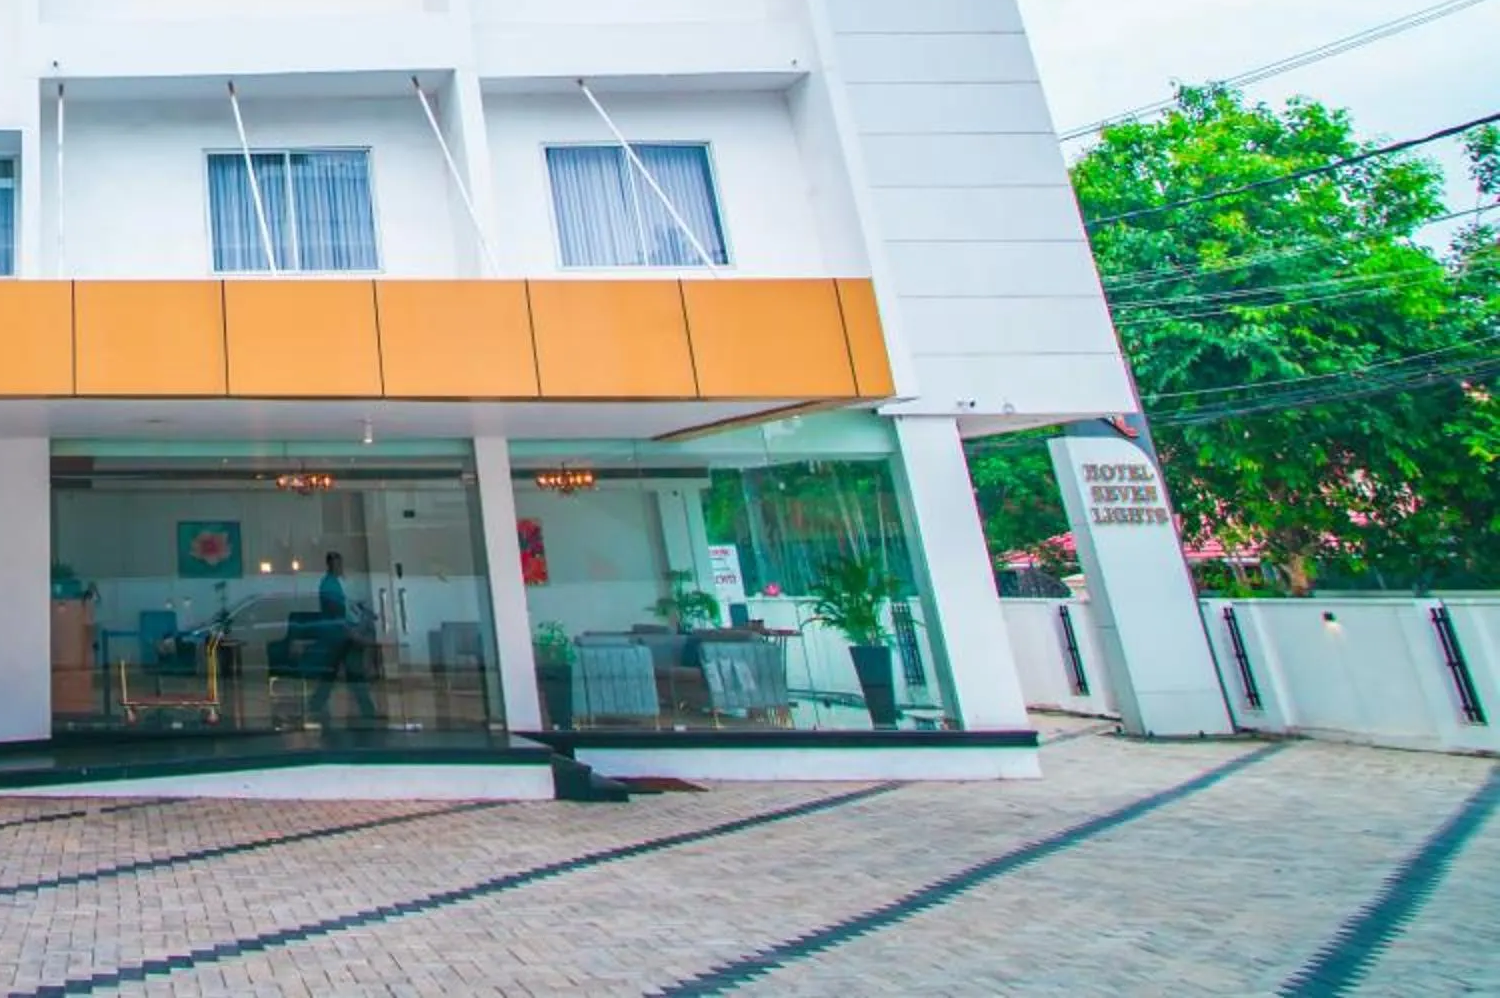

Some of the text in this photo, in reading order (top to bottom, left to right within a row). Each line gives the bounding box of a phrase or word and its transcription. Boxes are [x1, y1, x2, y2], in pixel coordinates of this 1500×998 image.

[1082, 464, 1155, 482] HOTEL
[1090, 485, 1158, 503] SEVEN
[1091, 507, 1169, 524] LIGHTS
